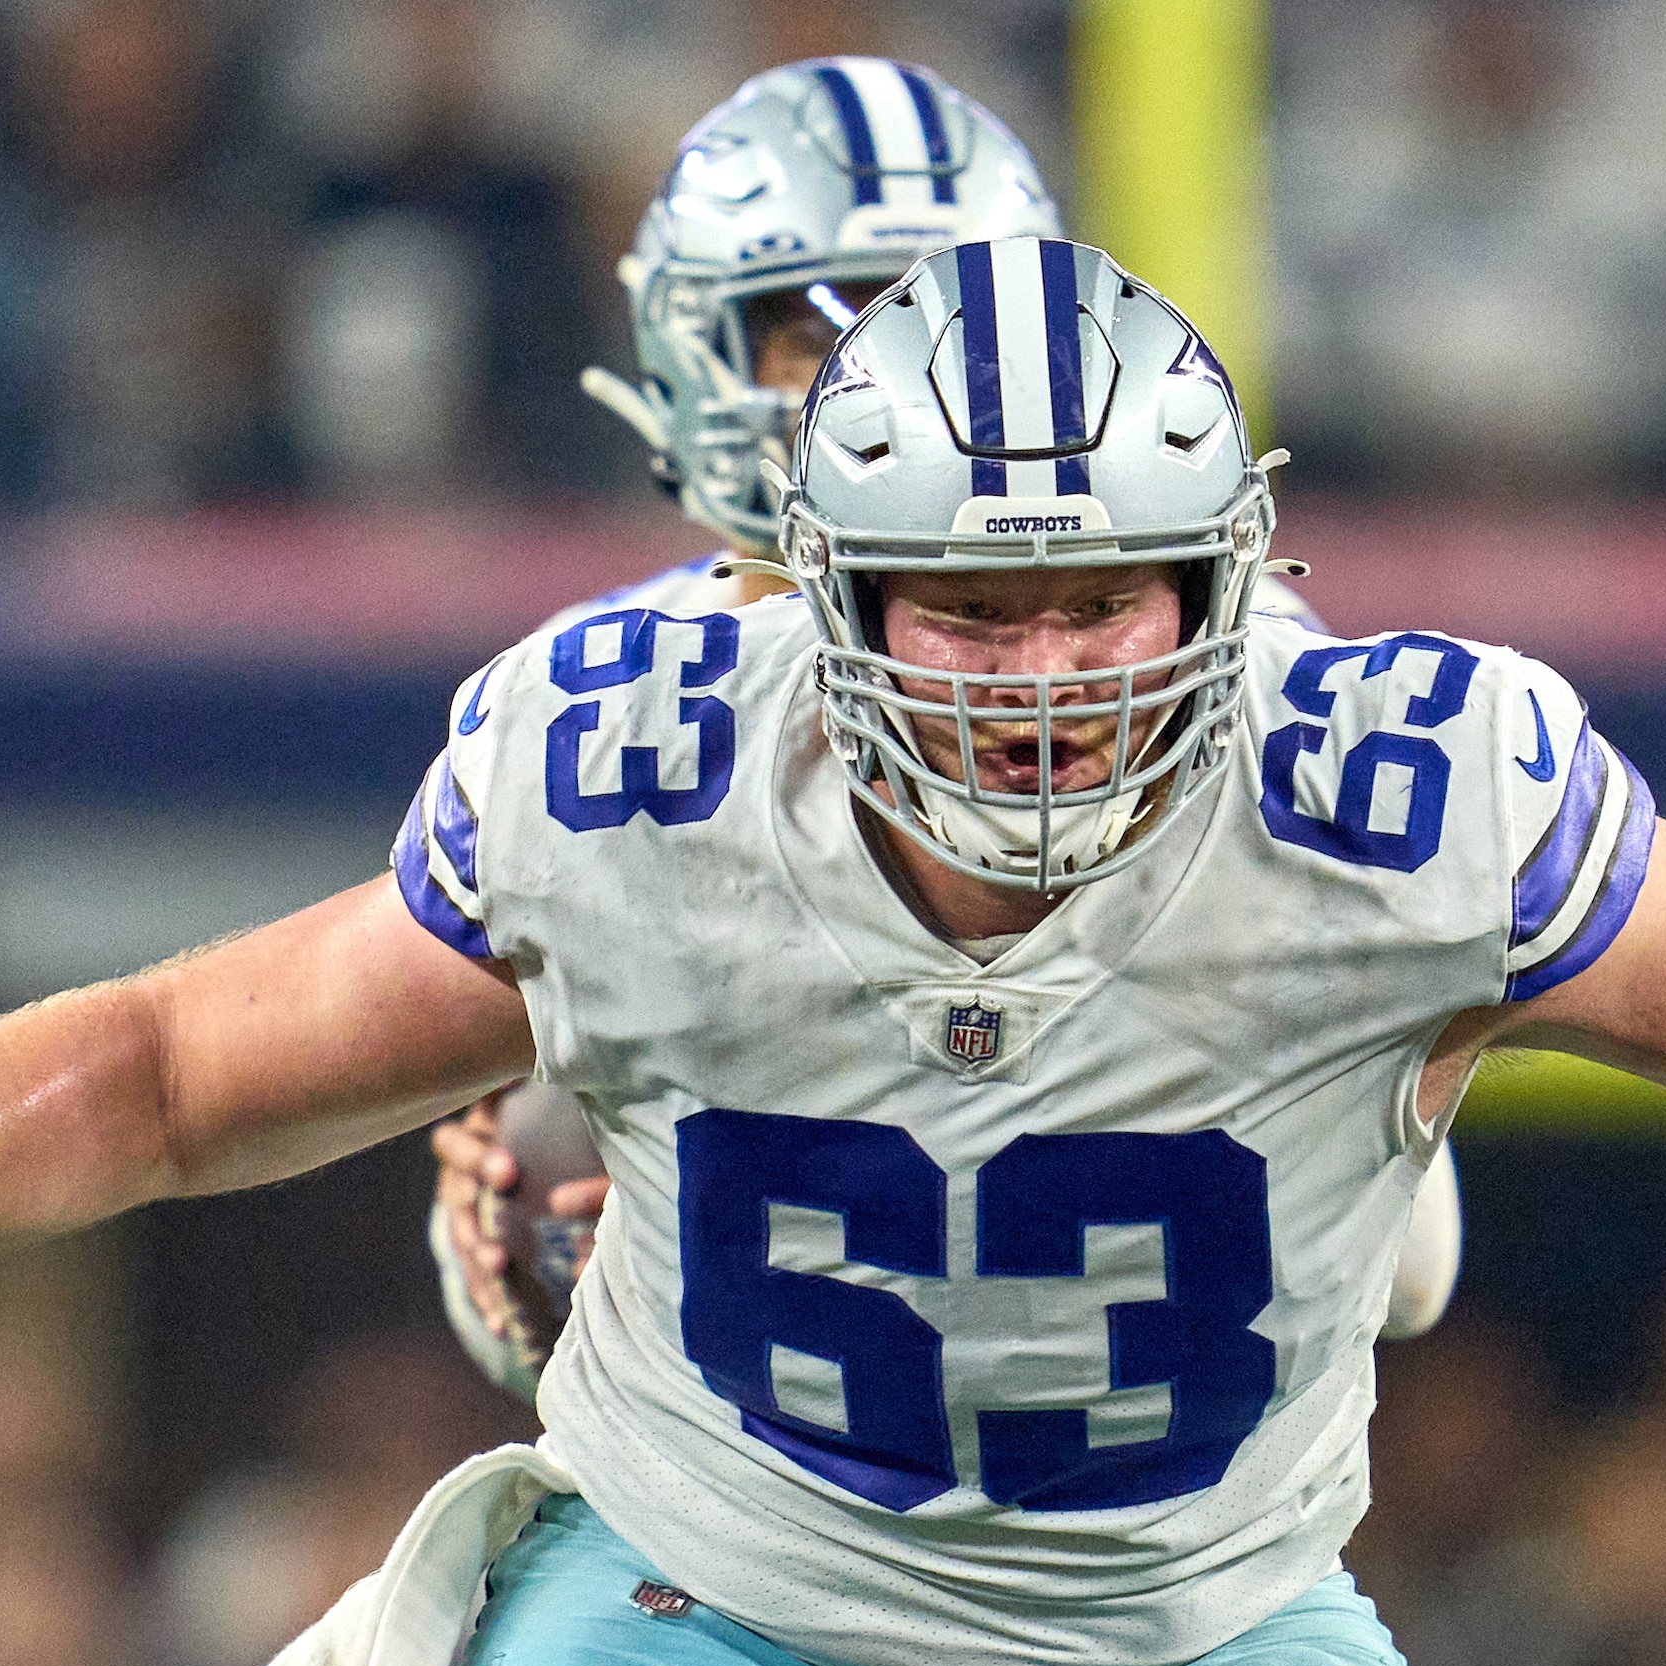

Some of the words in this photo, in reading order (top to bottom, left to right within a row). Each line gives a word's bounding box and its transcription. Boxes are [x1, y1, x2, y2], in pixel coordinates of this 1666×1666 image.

[985, 515, 1082, 534] COWBOYS
[545, 608, 741, 834] 63
[1258, 632, 1480, 874] 63
[951, 1027, 993, 1057] NFL
[676, 1108, 1275, 1514] 63
[638, 1591, 678, 1610] NFL
